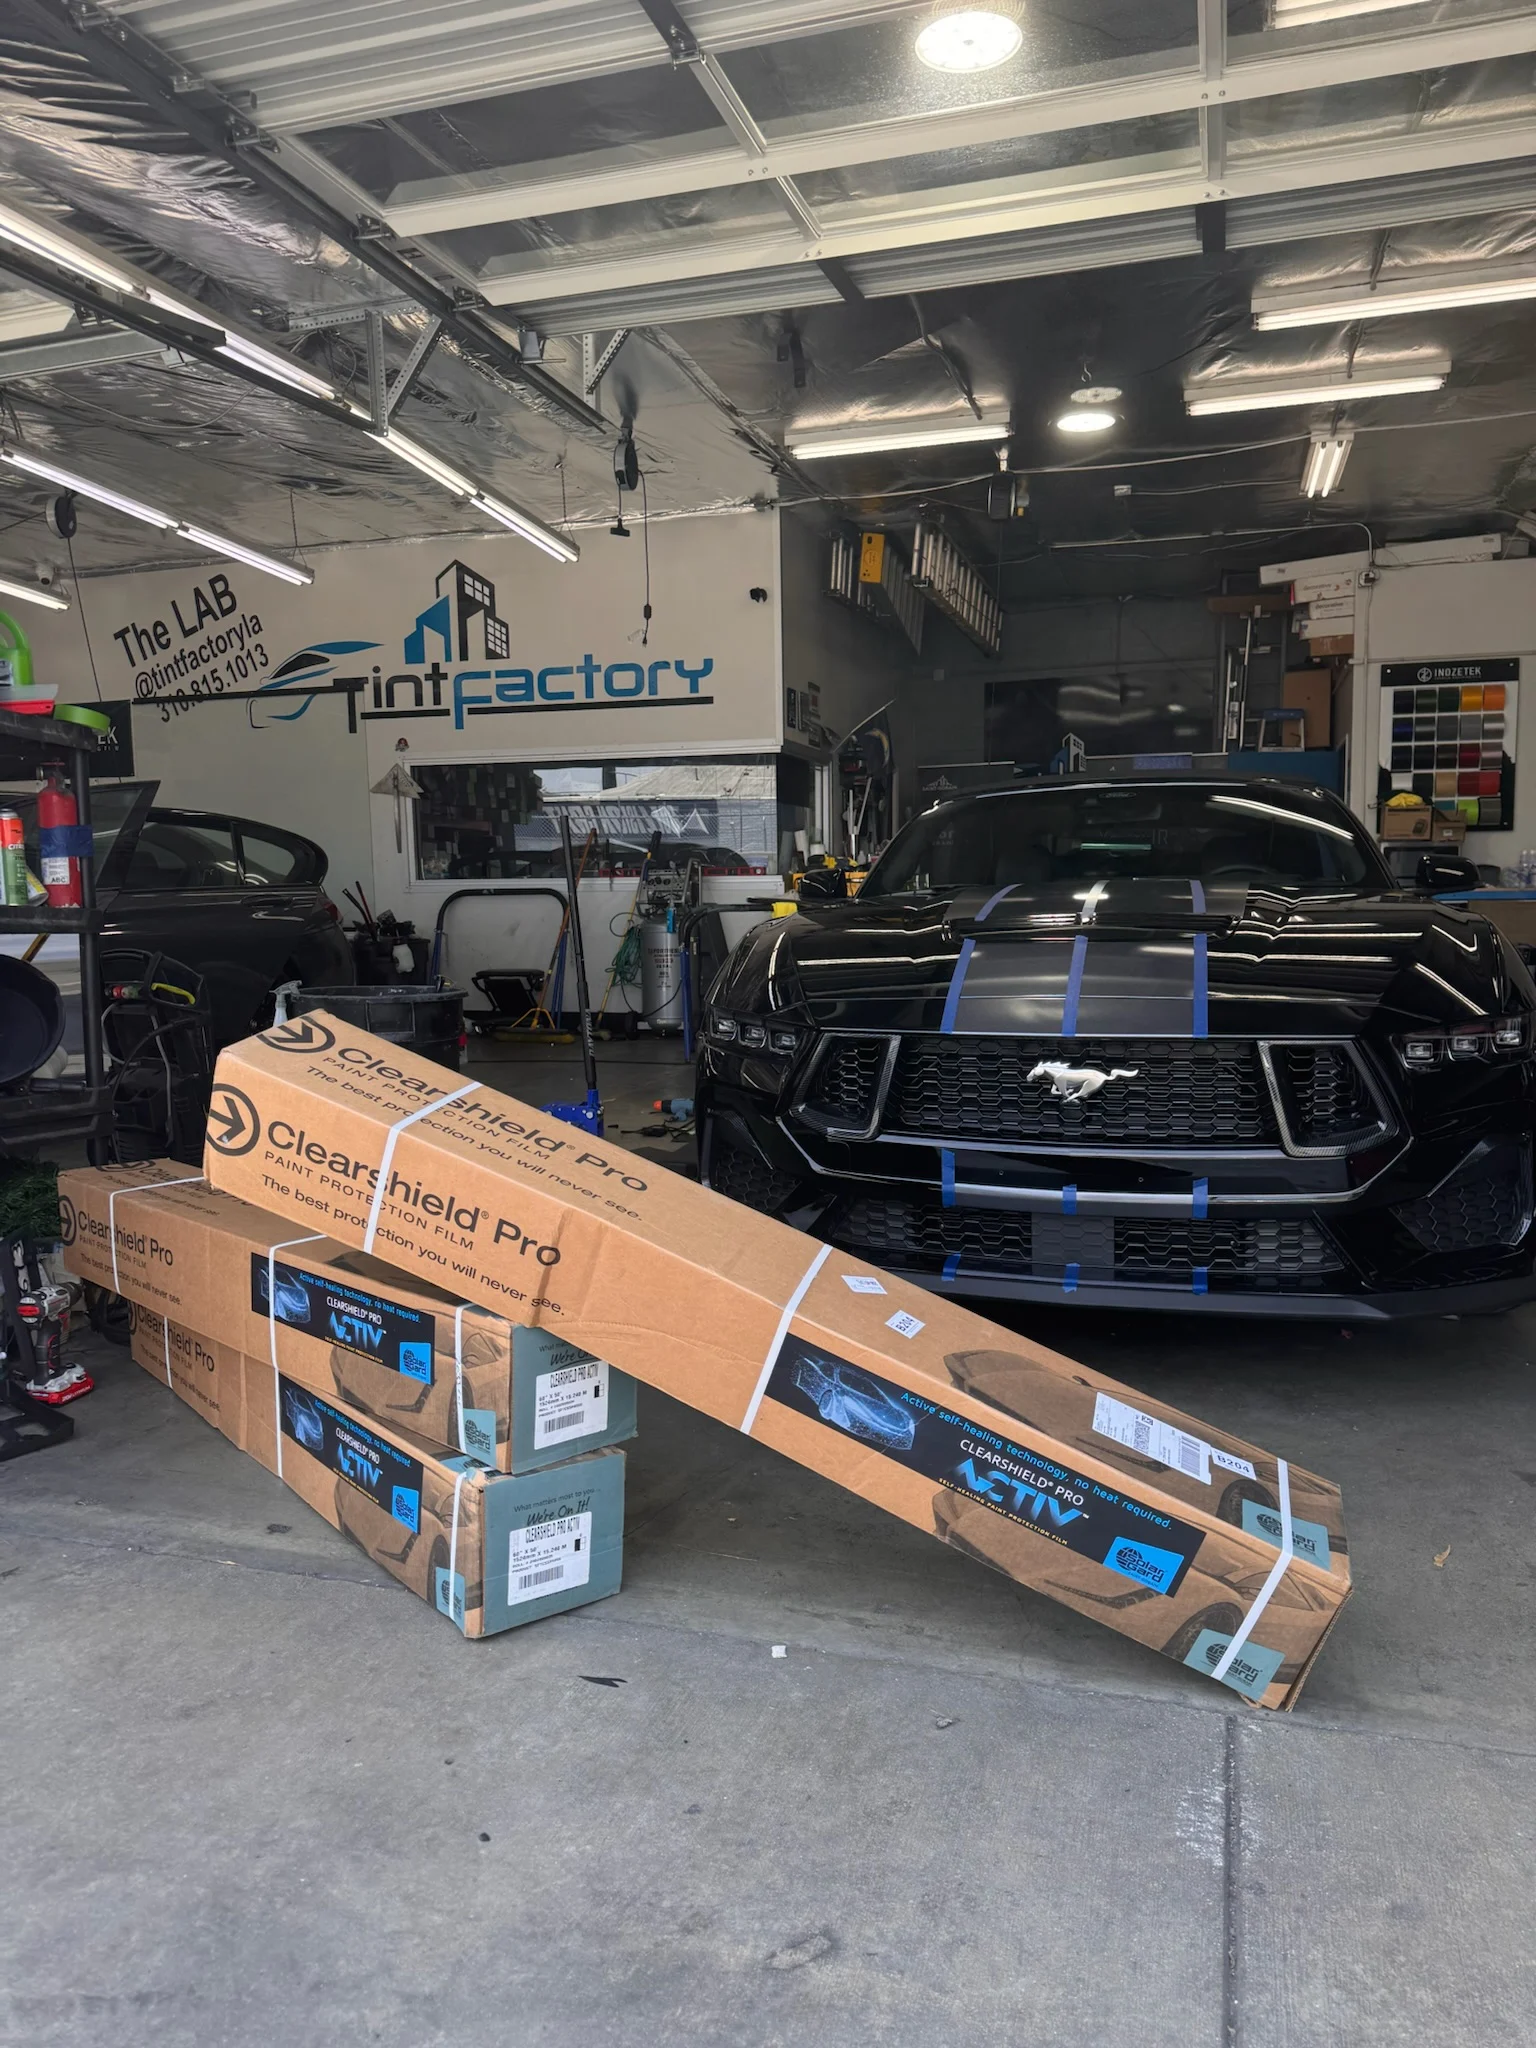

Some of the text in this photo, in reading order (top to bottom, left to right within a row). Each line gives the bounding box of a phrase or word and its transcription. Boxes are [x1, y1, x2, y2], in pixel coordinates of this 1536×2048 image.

[113, 573, 237, 668] The LAB
[135, 613, 263, 698] @tintfactoryla
[1434, 666, 1482, 677] INOZETEK
[323, 1057, 378, 1082] PAINT
[506, 1137, 550, 1161] FILM
[307, 1065, 642, 1221] The best proection you will never see.
[575, 1152, 648, 1192] Pro
[265, 1150, 314, 1178] PAINT
[434, 1225, 474, 1251] FILM
[150, 1238, 173, 1266] Pro
[262, 1173, 564, 1316] The best protction you will never see.
[493, 1218, 561, 1266] Pro
[369, 1312, 382, 1325] PRO
[195, 1342, 214, 1372] Pro
[550, 1349, 575, 1366] We're
[578, 1366, 587, 1381] PRO
[468, 1425, 491, 1441] Solar
[368, 1449, 380, 1464] PRO
[901, 1392, 1171, 1530] Active self-healing technology, no heat required.
[1217, 1455, 1250, 1473] B204
[514, 1503, 532, 1512] What
[533, 1497, 557, 1508] matters
[558, 1493, 574, 1502] most
[1055, 1486, 1084, 1506] PRO
[526, 1496, 590, 1526] We're On It!
[939, 1478, 1068, 1545] SELF-HEALING PAINT PROTECTION FILM
[525, 1522, 556, 1544] CLEARSHIELD
[556, 1519, 566, 1536] PRO
[1127, 1562, 1163, 1583] Gard
[1130, 1556, 1165, 1575] Solar
